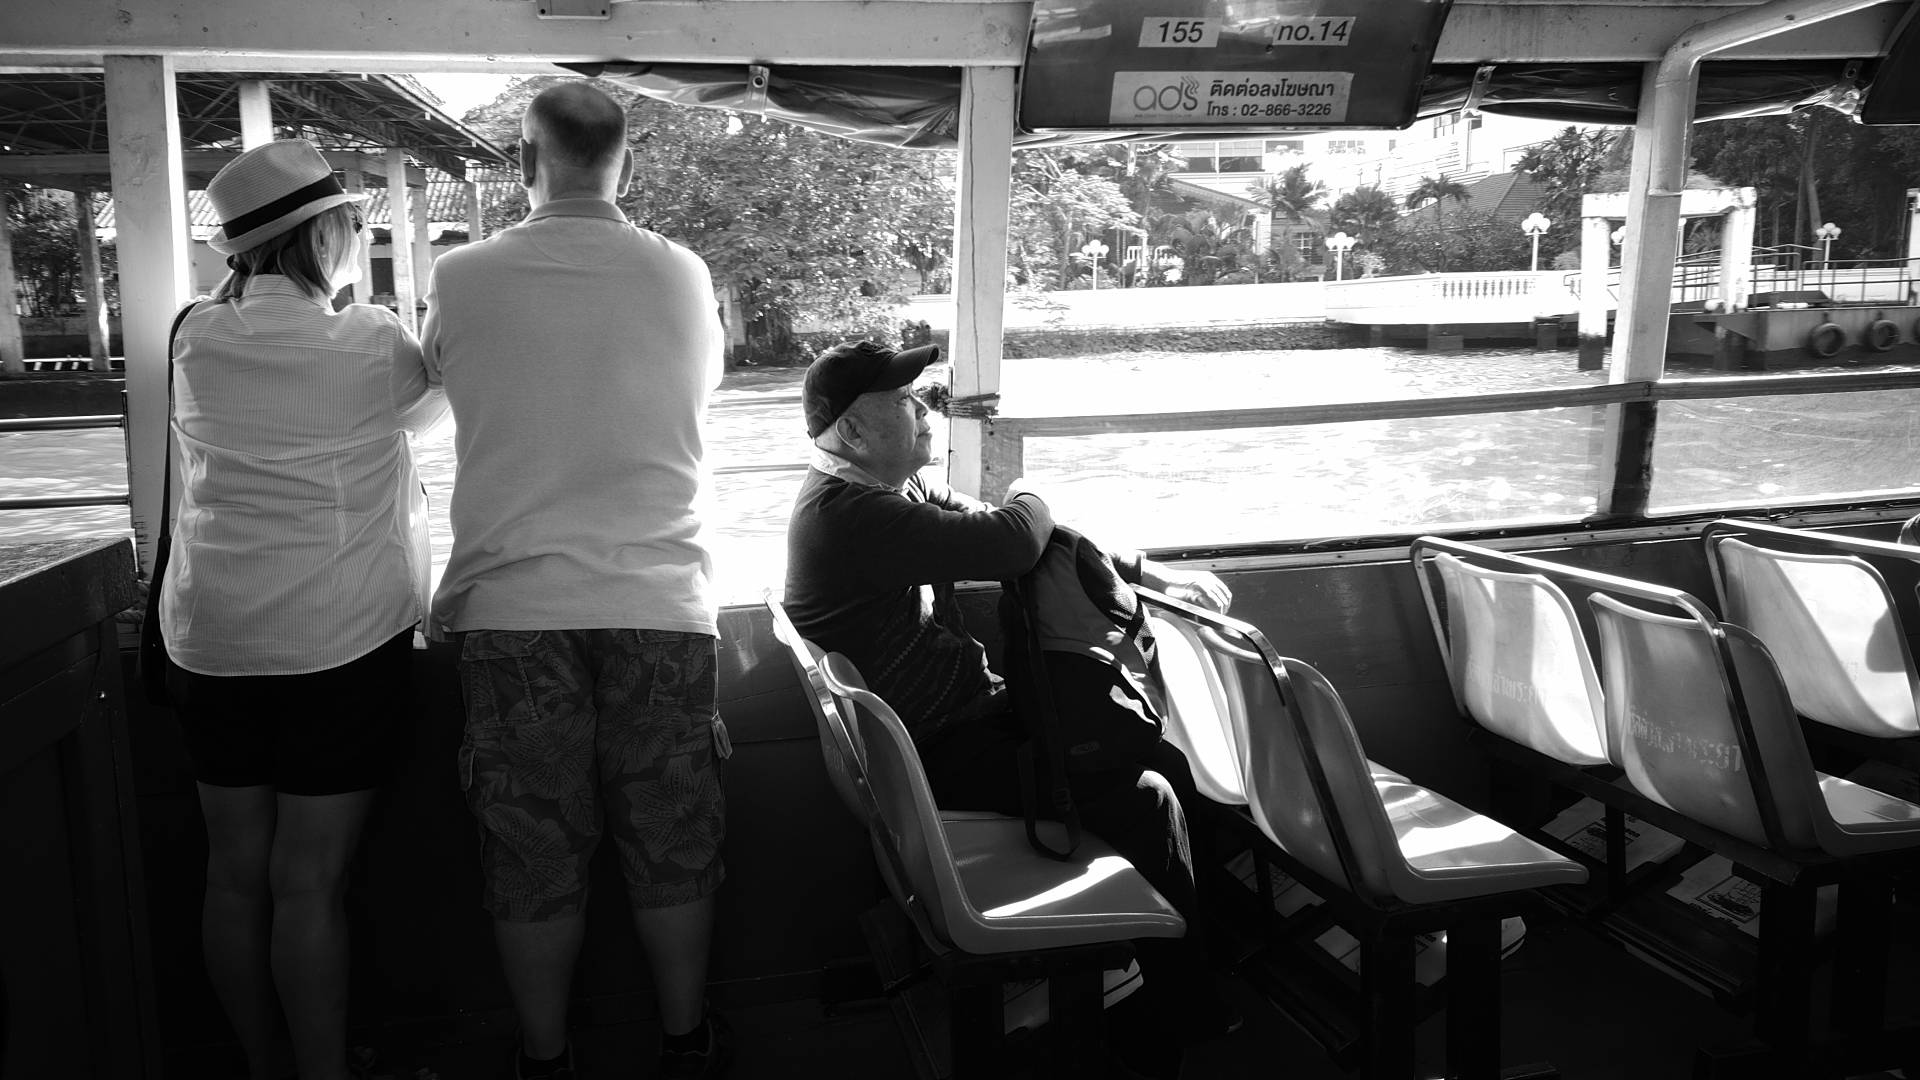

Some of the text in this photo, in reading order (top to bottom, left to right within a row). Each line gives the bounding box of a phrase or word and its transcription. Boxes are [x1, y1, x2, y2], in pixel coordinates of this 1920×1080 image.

[1159, 20, 1205, 43] 155
[1277, 19, 1350, 42] no.14
[1133, 75, 1200, 111] ads
[1209, 78, 1335, 98] ติดต่อลงโฆษณา
[1206, 101, 1230, 117] โทร
[1240, 102, 1333, 117] 02-866-3226
